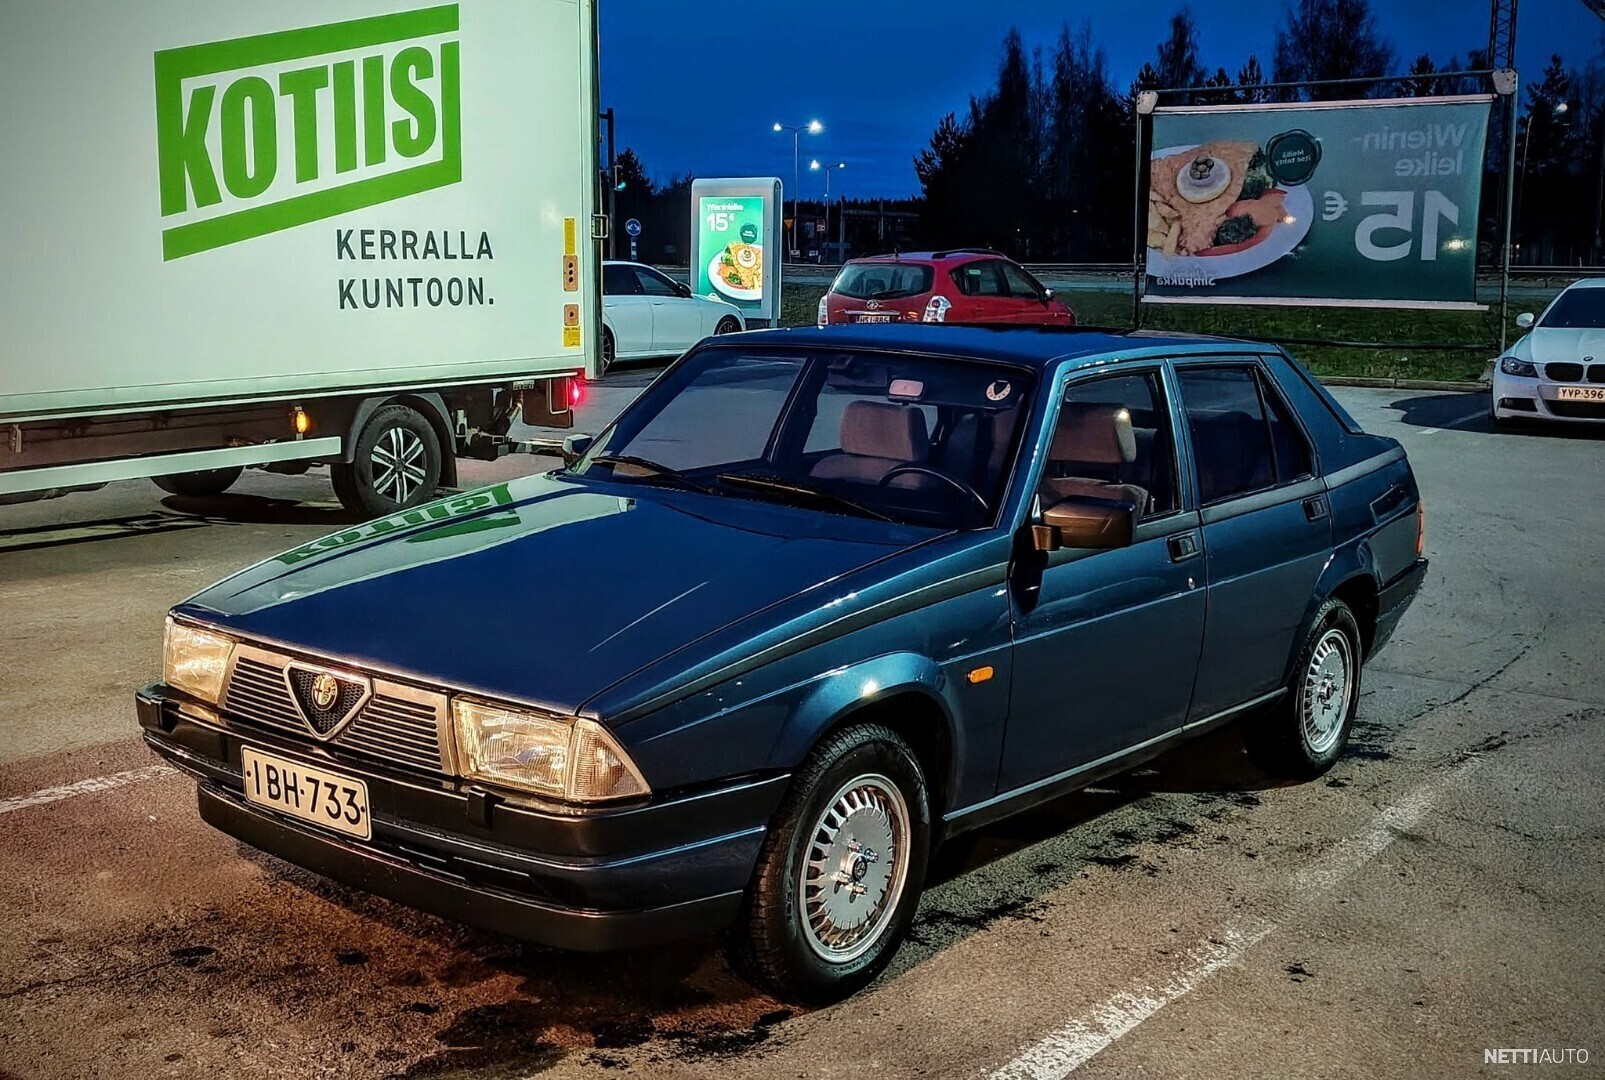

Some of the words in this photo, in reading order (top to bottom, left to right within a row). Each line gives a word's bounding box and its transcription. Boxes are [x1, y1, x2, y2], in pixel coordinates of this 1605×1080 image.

[336, 228, 494, 261] KERRALLA
[338, 275, 495, 310] KUNTOON.
[1561, 388, 1604, 400] YVP-396
[253, 759, 362, 826] IBH-733
